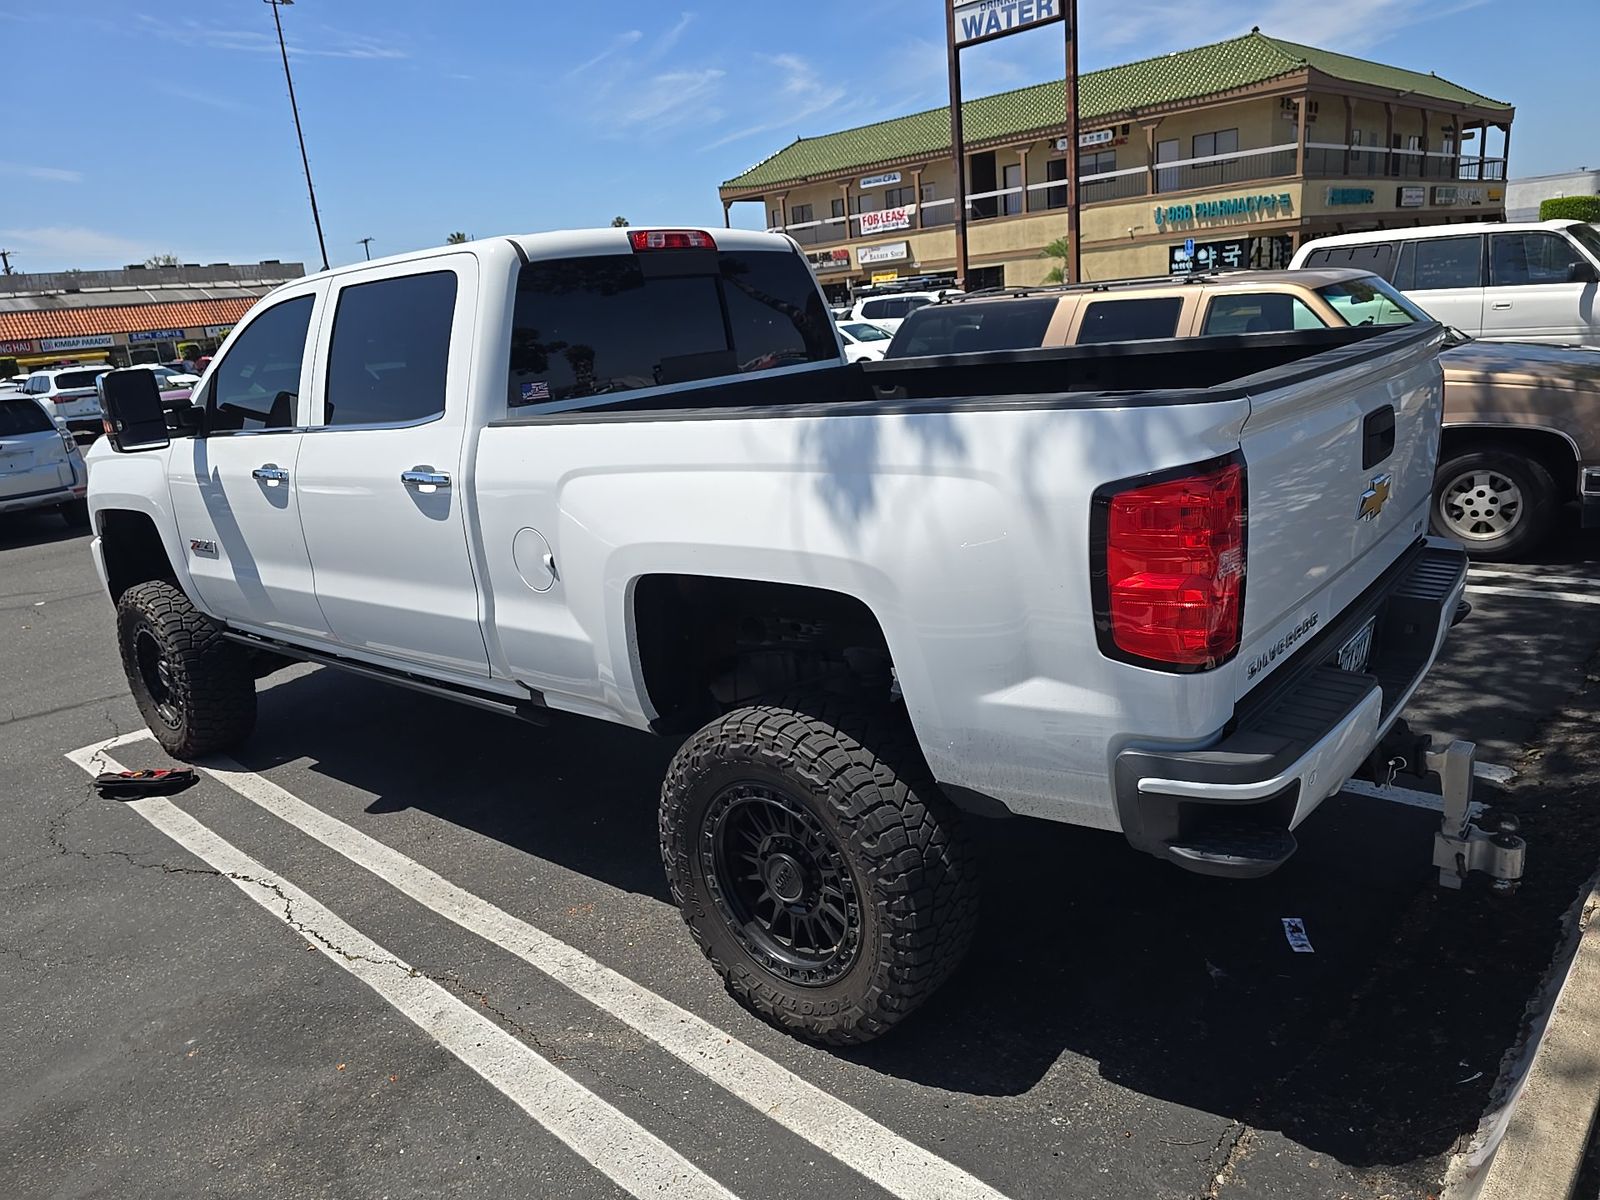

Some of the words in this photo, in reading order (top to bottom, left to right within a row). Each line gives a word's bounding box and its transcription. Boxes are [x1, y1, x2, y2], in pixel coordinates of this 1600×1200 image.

[961, 0, 1054, 40] WATER
[883, 173, 898, 182] CPA
[1195, 195, 1264, 218] PHARMACY
[862, 213, 880, 226] FOR
[1197, 244, 1242, 270] 약국
[13, 342, 31, 352] HAU
[54, 339, 81, 348] KIMBAP
[81, 337, 112, 346] PARADISE
